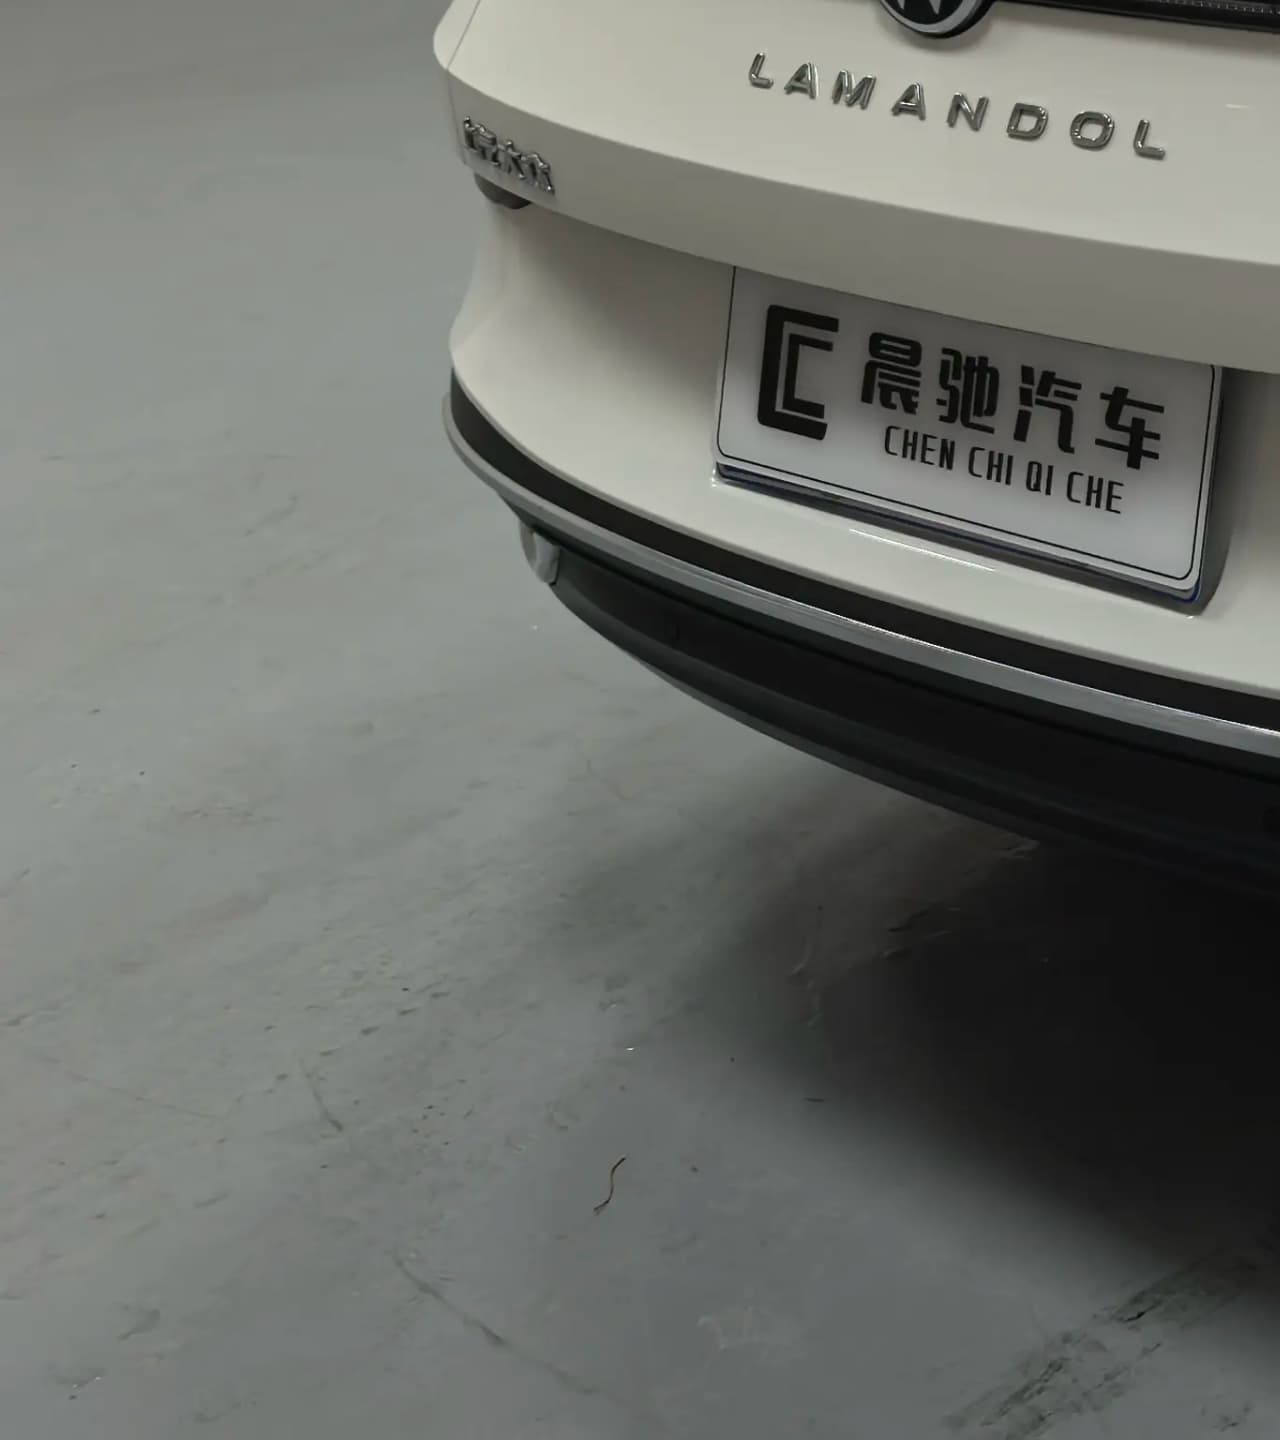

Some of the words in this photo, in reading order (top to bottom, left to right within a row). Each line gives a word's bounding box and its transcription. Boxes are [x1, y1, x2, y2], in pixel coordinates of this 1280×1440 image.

[860, 331, 1166, 470] 晨驰汽车
[884, 424, 956, 472] CHEN
[967, 446, 1013, 486] CHI
[1025, 460, 1054, 497] QI
[1065, 471, 1125, 515] CHE
